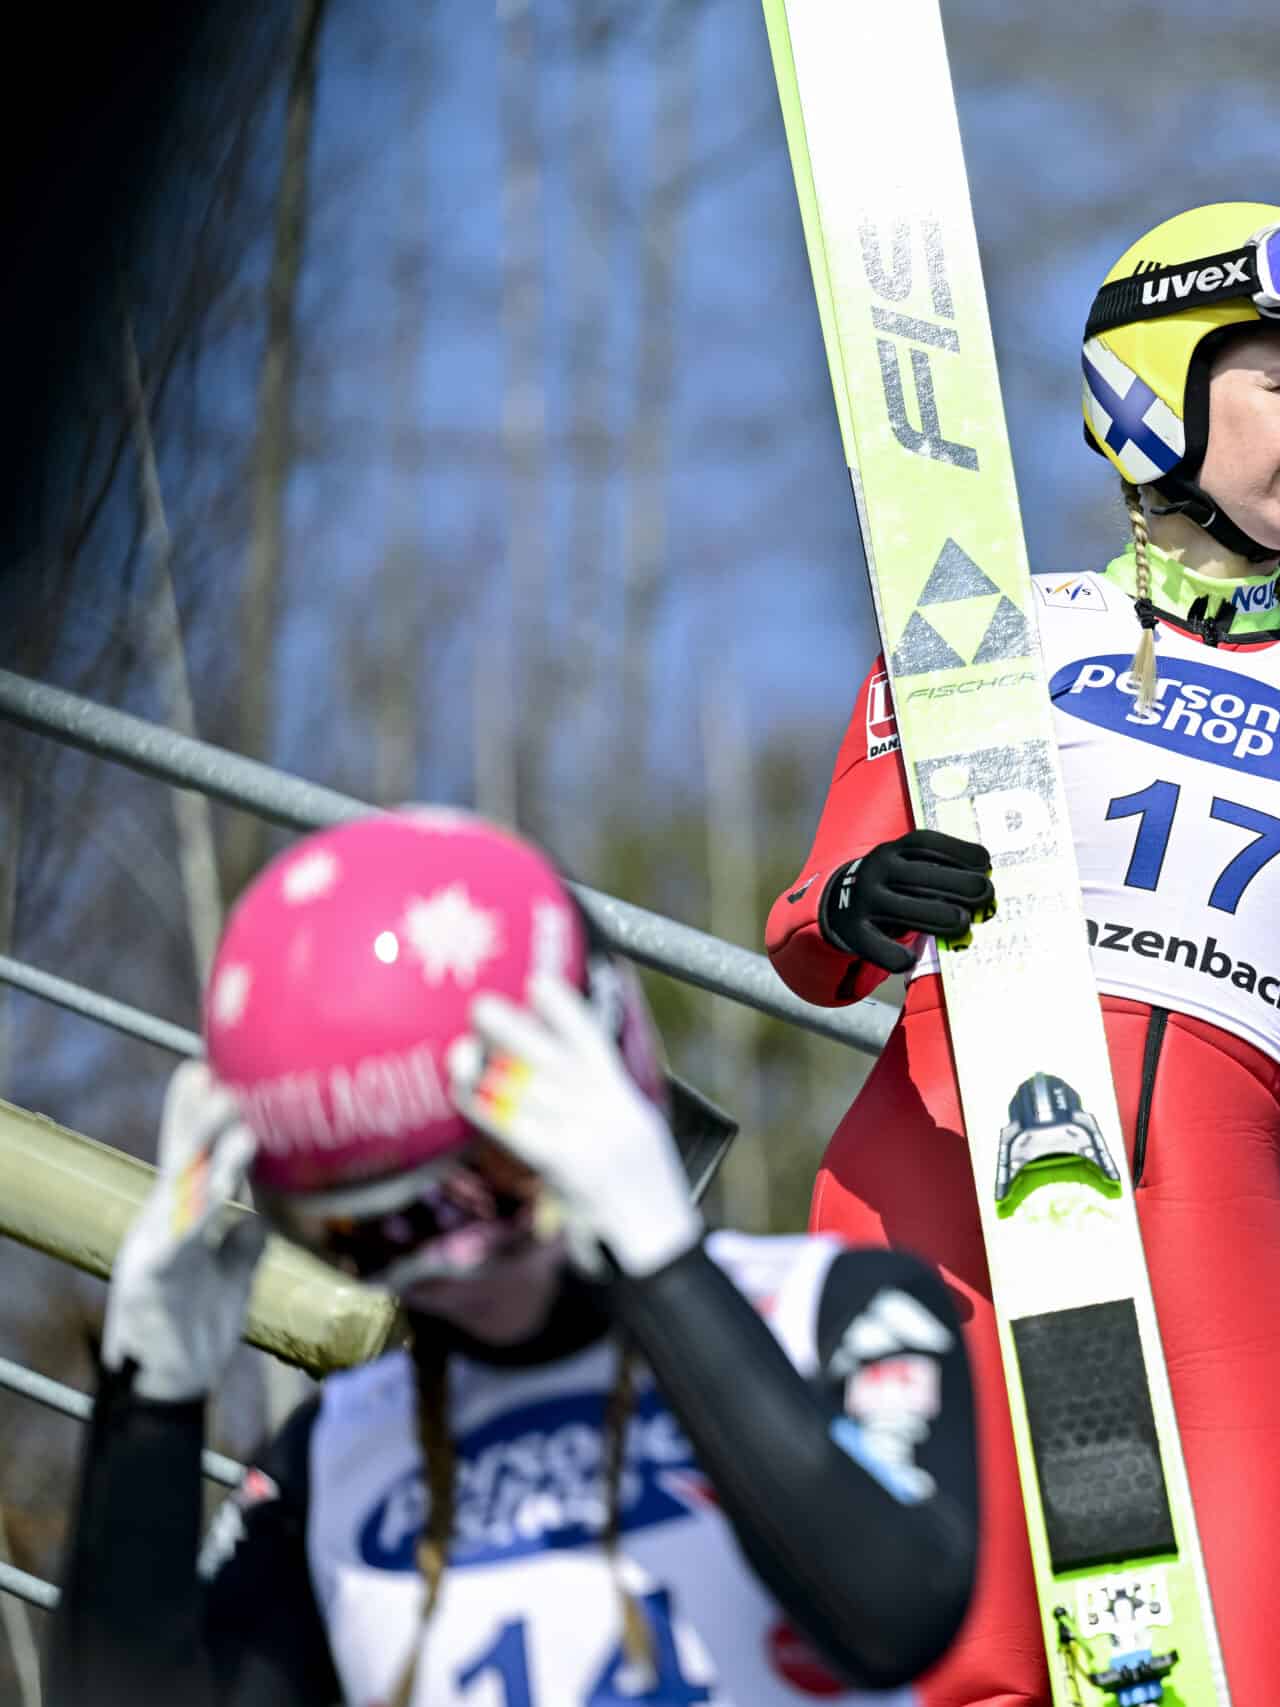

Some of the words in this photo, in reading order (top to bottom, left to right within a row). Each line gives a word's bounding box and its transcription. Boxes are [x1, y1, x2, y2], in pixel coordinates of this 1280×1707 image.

[1142, 257, 1251, 305] uvex
[870, 737, 901, 758] DAN
[1126, 697, 1274, 759] shop
[456, 1583, 717, 1706] 14
